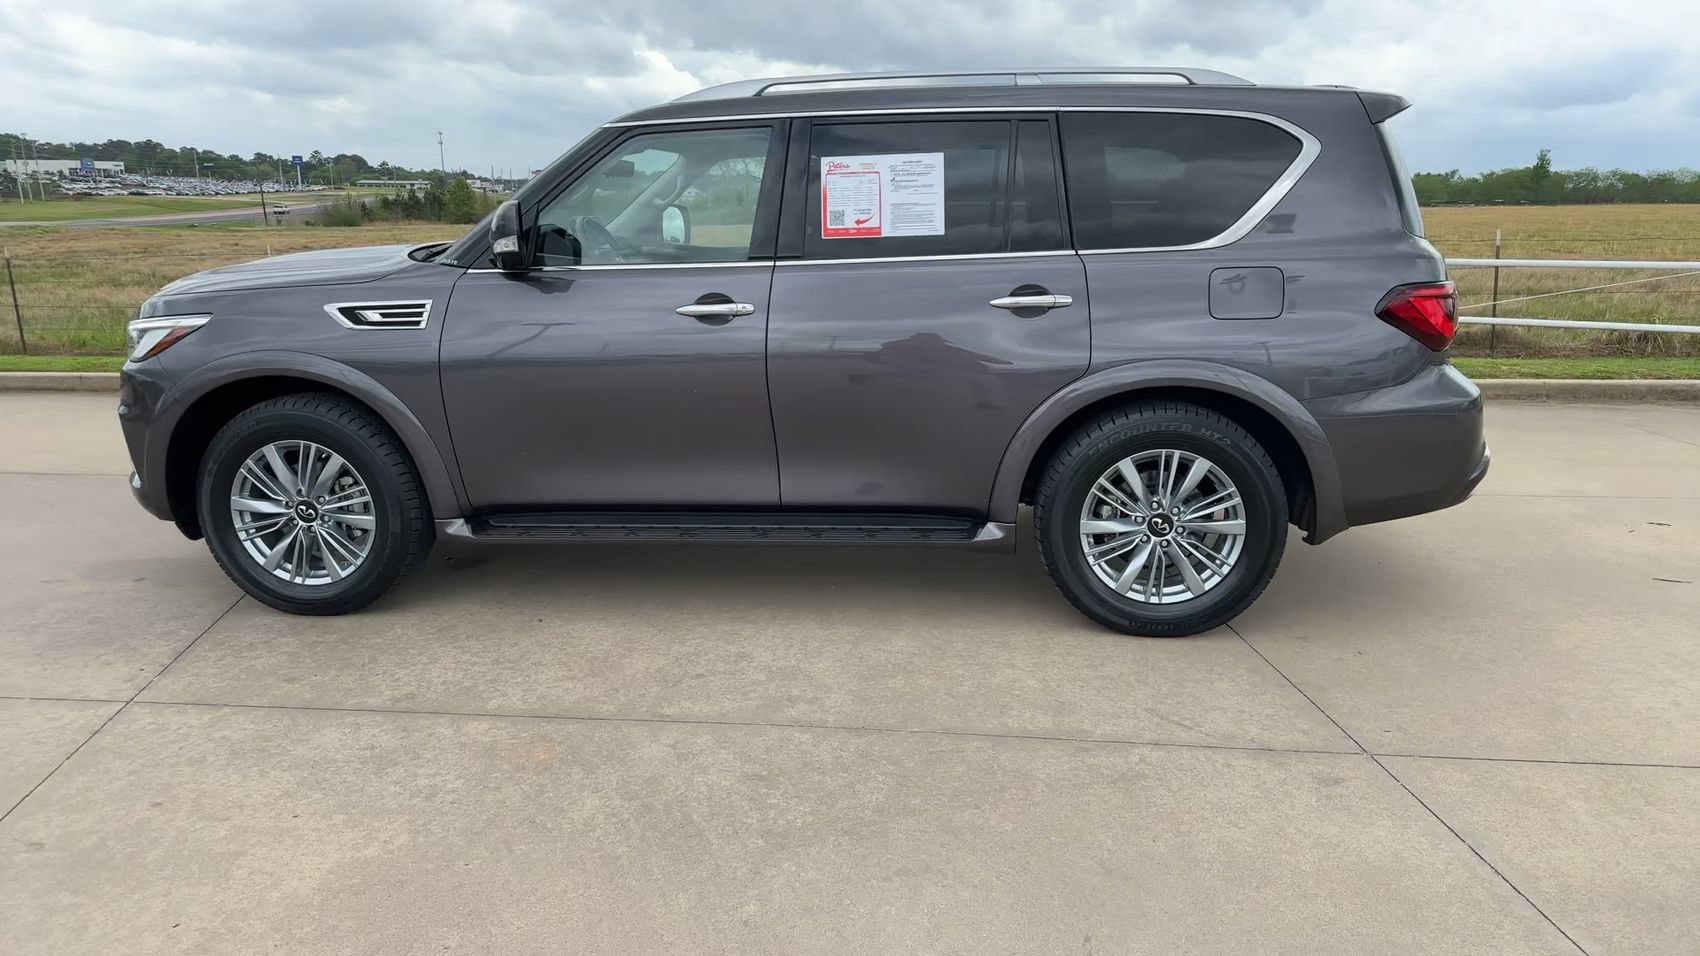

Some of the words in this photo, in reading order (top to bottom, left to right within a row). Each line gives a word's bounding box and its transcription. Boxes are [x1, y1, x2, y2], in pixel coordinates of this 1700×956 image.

[825, 161, 851, 171] Peters
[1088, 423, 1193, 454] ENCOUNTER
[1200, 427, 1232, 445] HT2
